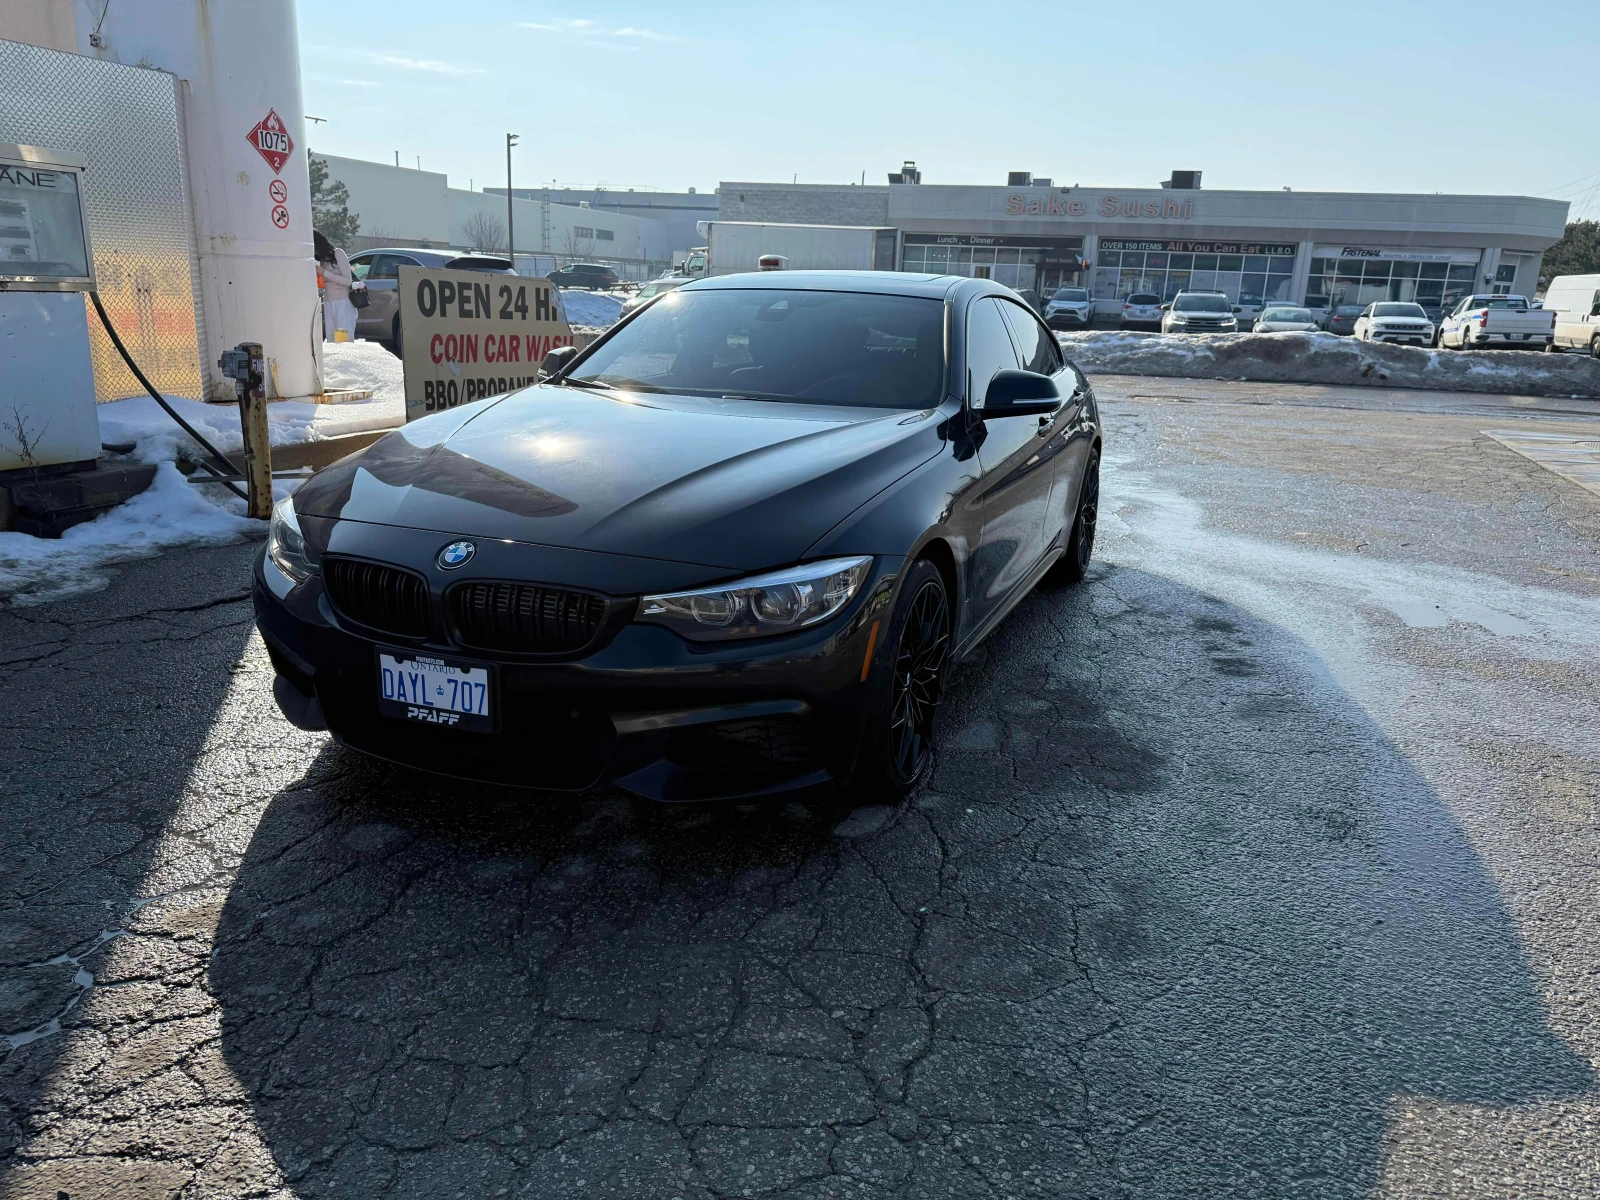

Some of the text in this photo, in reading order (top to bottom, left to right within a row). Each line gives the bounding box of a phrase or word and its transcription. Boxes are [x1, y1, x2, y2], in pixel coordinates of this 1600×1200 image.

[259, 130, 287, 151] 1075
[274, 157, 280, 167] 2
[1005, 194, 1194, 218] Sake Sushi
[937, 235, 995, 244] Lunch Dinner
[1102, 241, 1123, 249] OVER
[1125, 242, 1138, 250] 150
[1166, 241, 1184, 251] All
[1187, 242, 1210, 252] You
[1213, 242, 1237, 253] Can
[1240, 243, 1261, 254] Eat
[417, 279, 491, 319] OPEN
[499, 285, 529, 320] 24
[430, 333, 479, 364] COIN
[484, 334, 520, 363] CAR
[424, 376, 534, 411] BBQ/PROP
[411, 661, 456, 675] ONTARIO
[382, 667, 486, 714] DAYL 707
[407, 706, 460, 725] PFAFF
